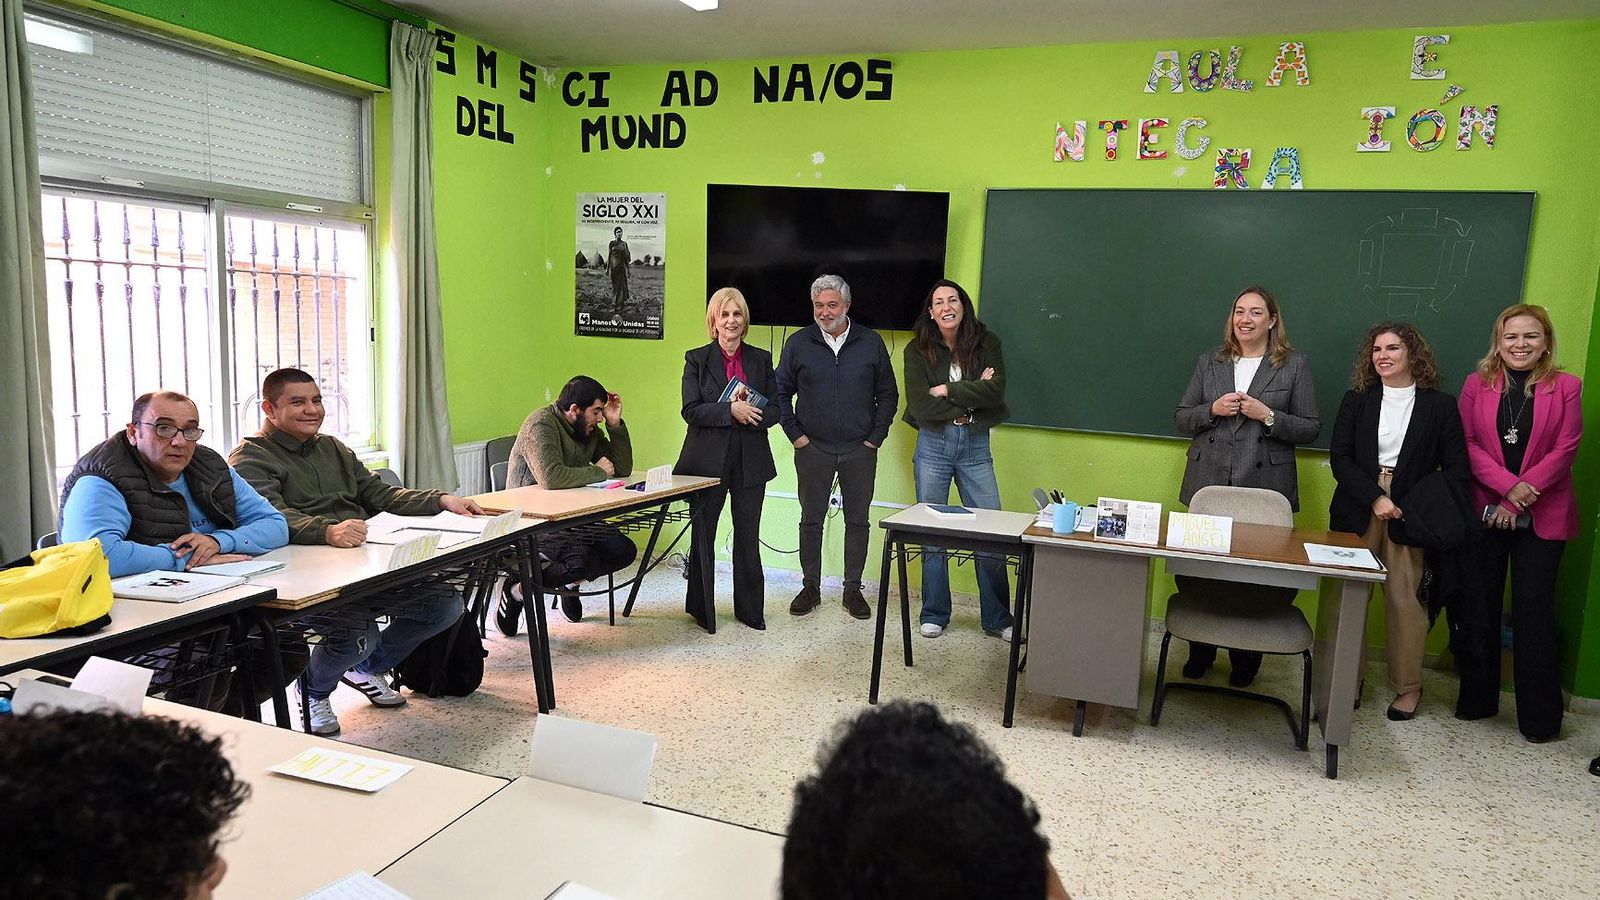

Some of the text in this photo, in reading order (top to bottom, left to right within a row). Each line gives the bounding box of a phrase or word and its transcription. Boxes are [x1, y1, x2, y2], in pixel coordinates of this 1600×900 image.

[477, 44, 497, 89] M
[753, 59, 892, 103] NA/OS
[1144, 41, 1310, 94] AULA
[456, 95, 686, 153] DEL MUND
[1356, 83, 1499, 153] IÓN
[583, 204, 659, 218] SIGLO XXI
[1174, 512, 1222, 531] MIGUEL
